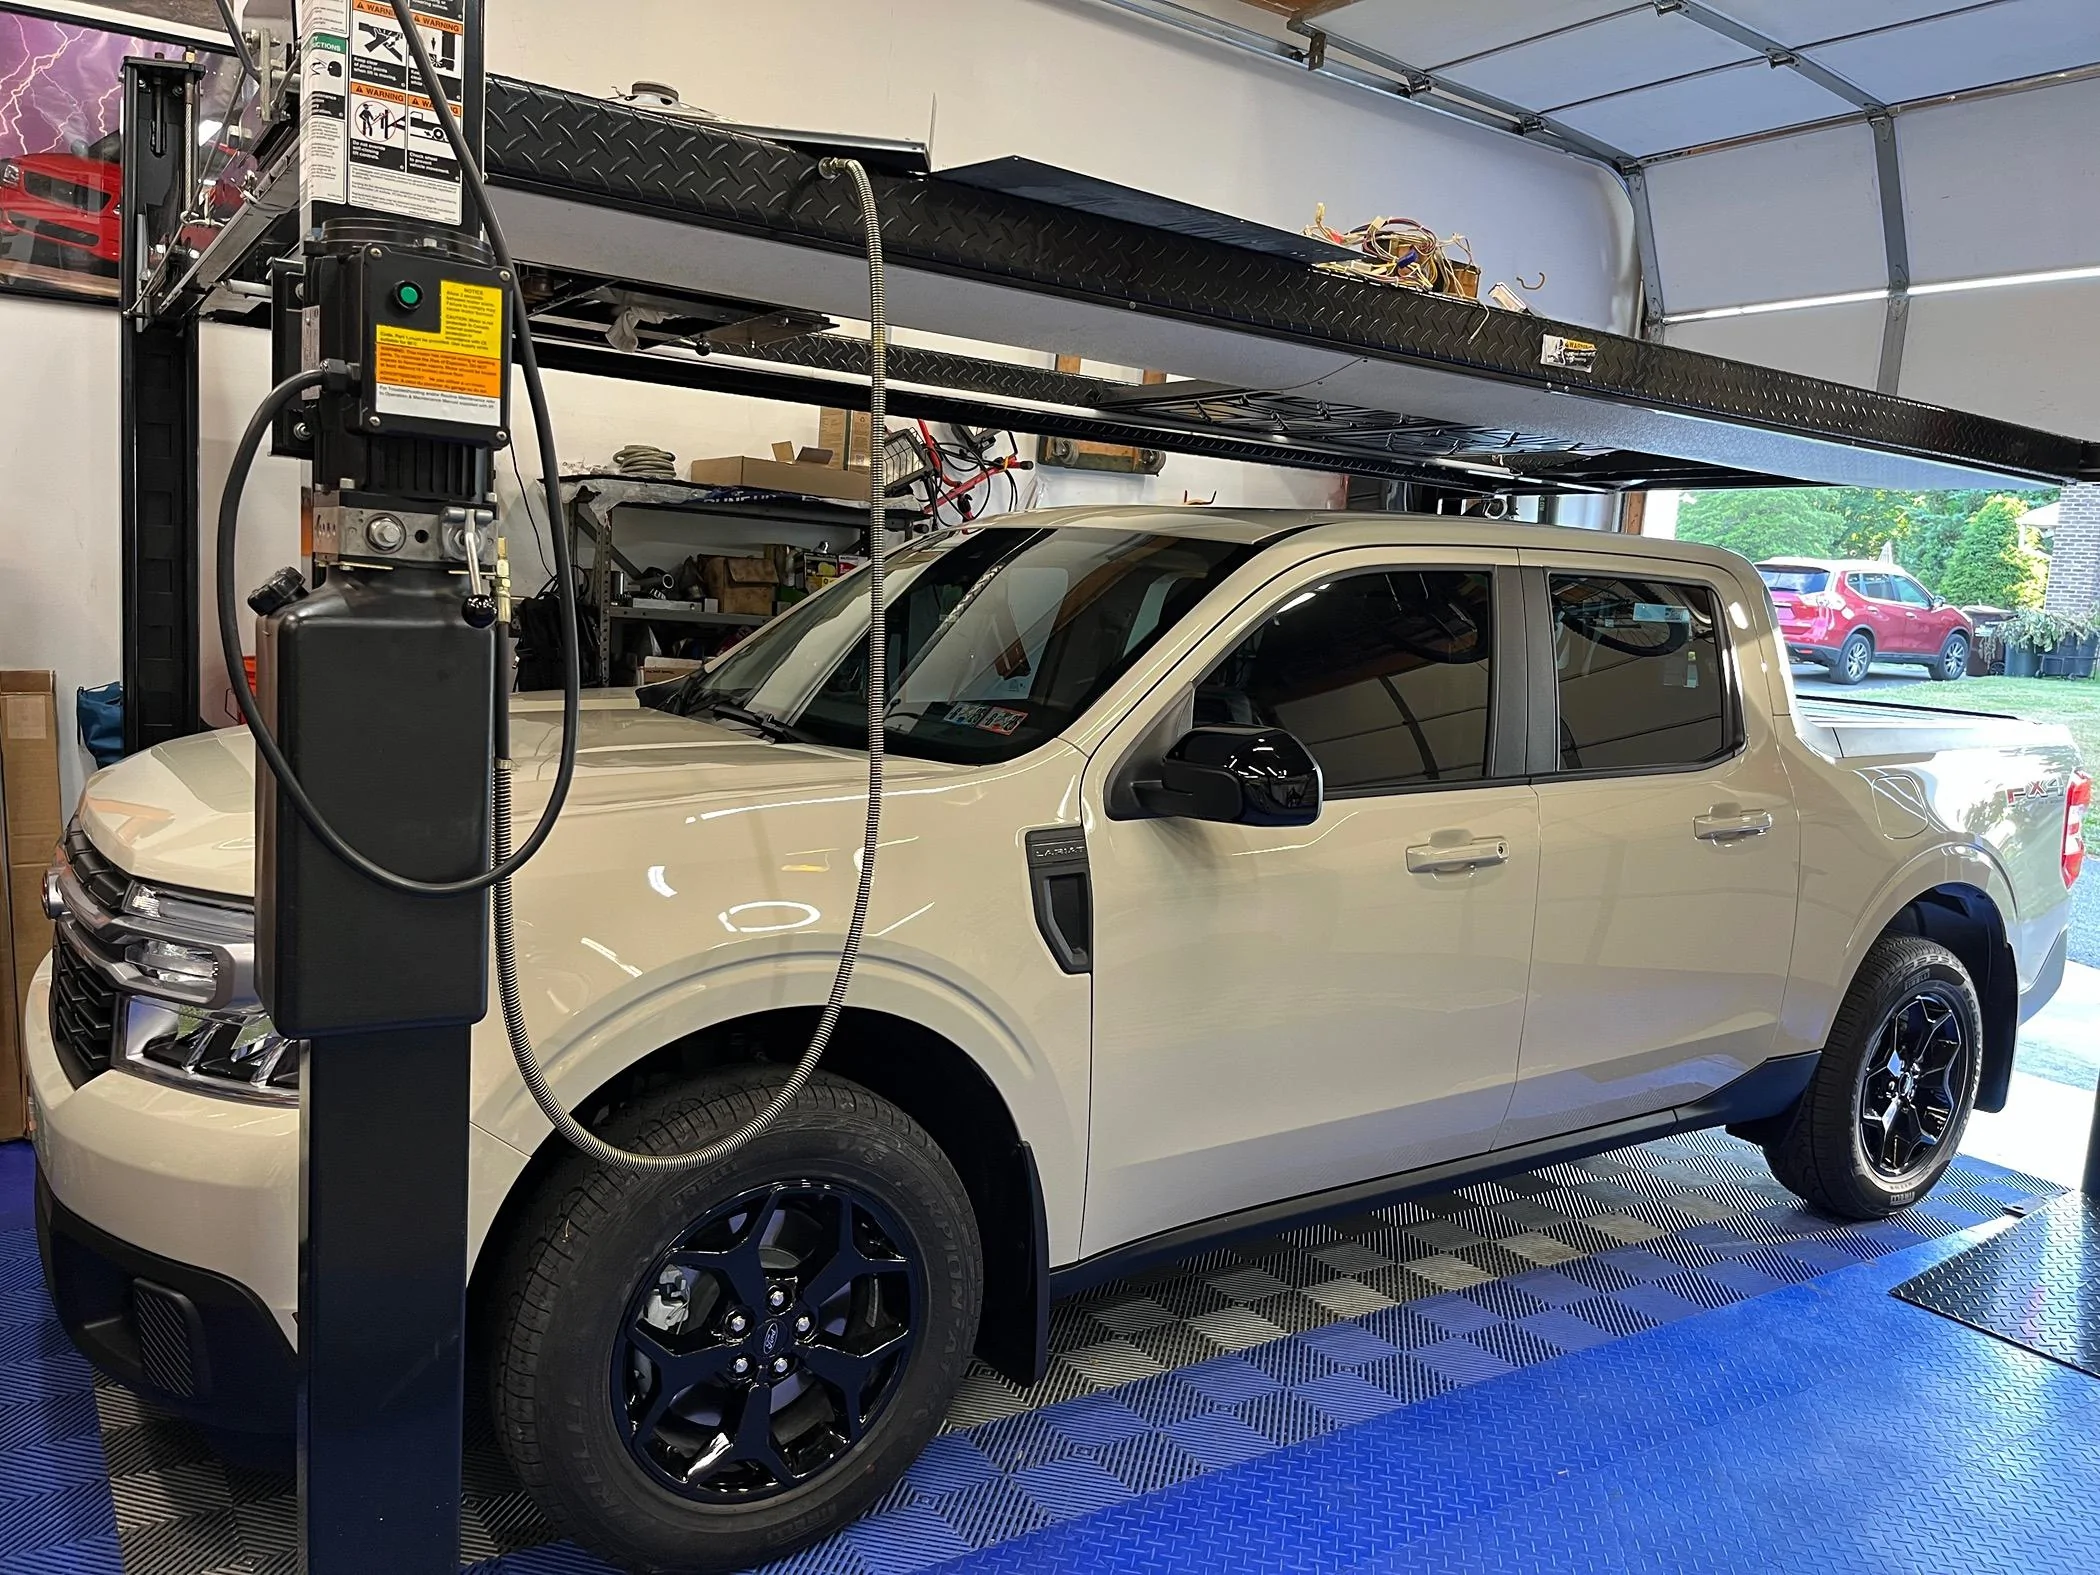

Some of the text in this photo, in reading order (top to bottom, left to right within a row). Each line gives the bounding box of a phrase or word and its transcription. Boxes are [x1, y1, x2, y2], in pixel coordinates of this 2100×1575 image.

[367, 4, 393, 16] WARNI
[423, 17, 459, 32] WARNING
[366, 87, 404, 102] WARNING
[2006, 775, 2065, 807] FX4
[1036, 846, 1085, 857] LARIAT
